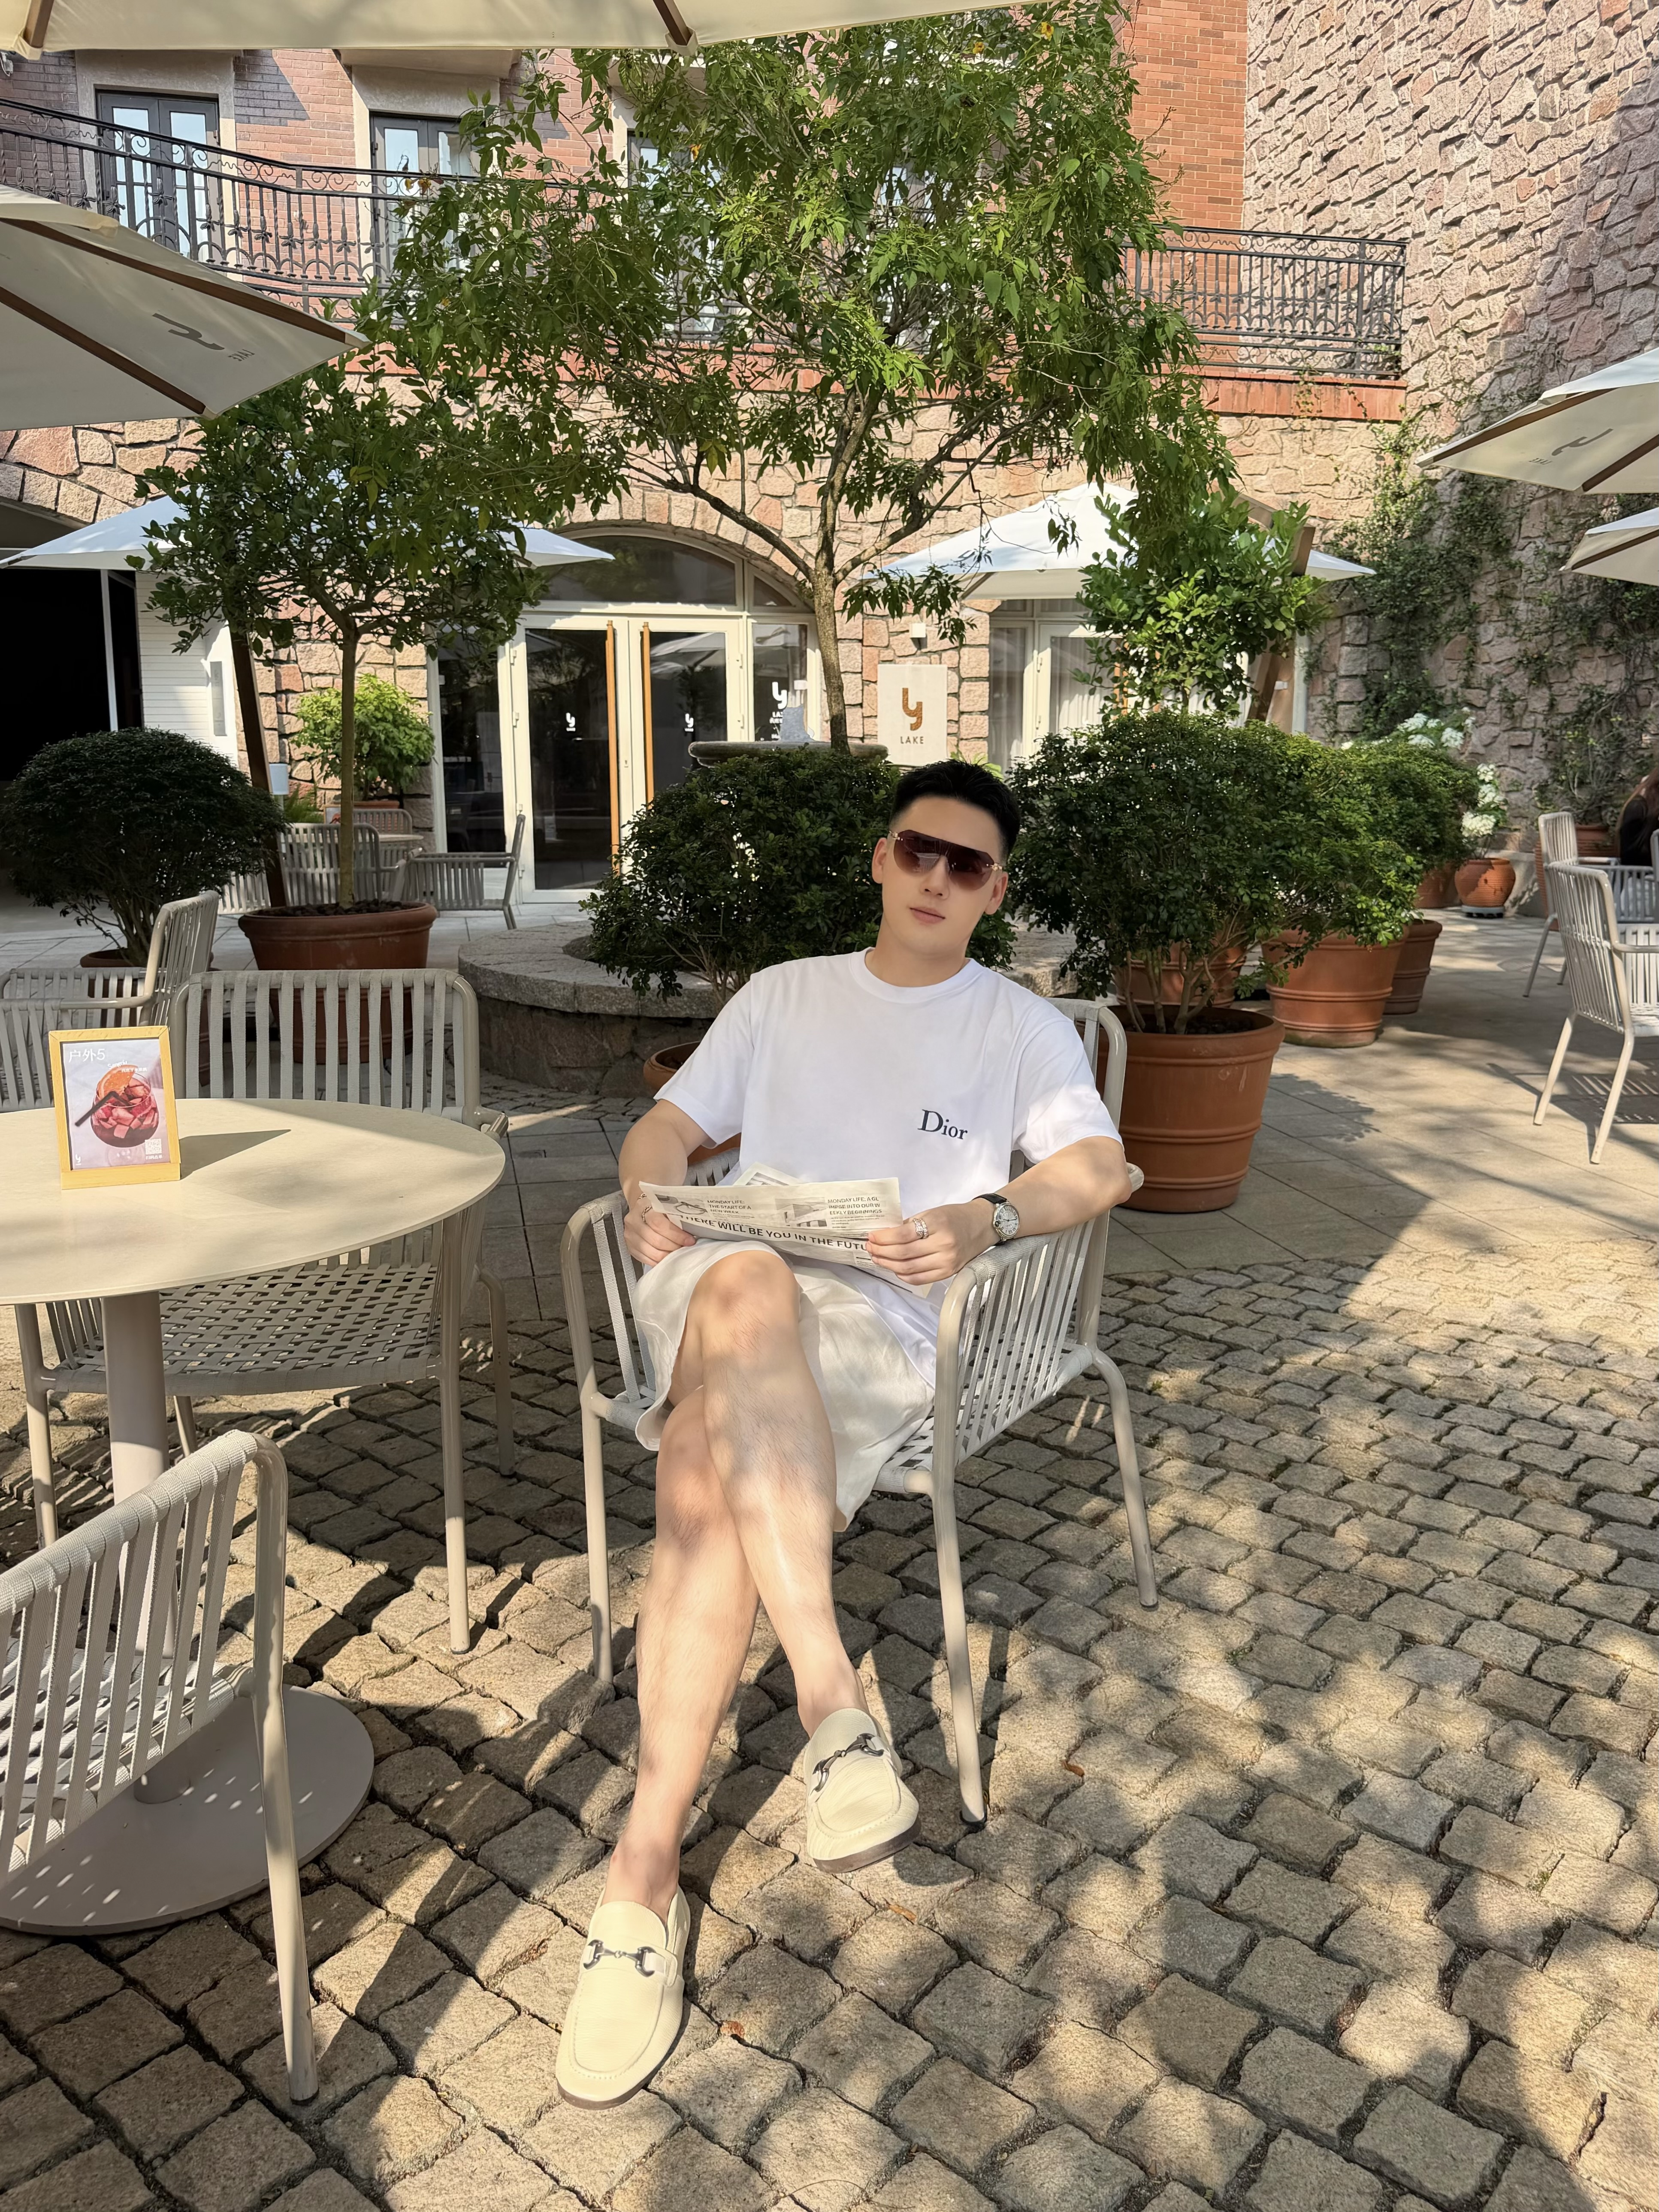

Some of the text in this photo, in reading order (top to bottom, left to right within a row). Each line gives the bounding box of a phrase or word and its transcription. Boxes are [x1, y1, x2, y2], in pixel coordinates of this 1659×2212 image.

[900, 736, 924, 744] LAKE
[69, 1048, 105, 1063] 户外5
[917, 1109, 968, 1139] Dior
[718, 1222, 746, 1233] WILL
[749, 1227, 763, 1236] BE
[766, 1230, 791, 1239] YOU
[810, 1236, 834, 1246] THE
